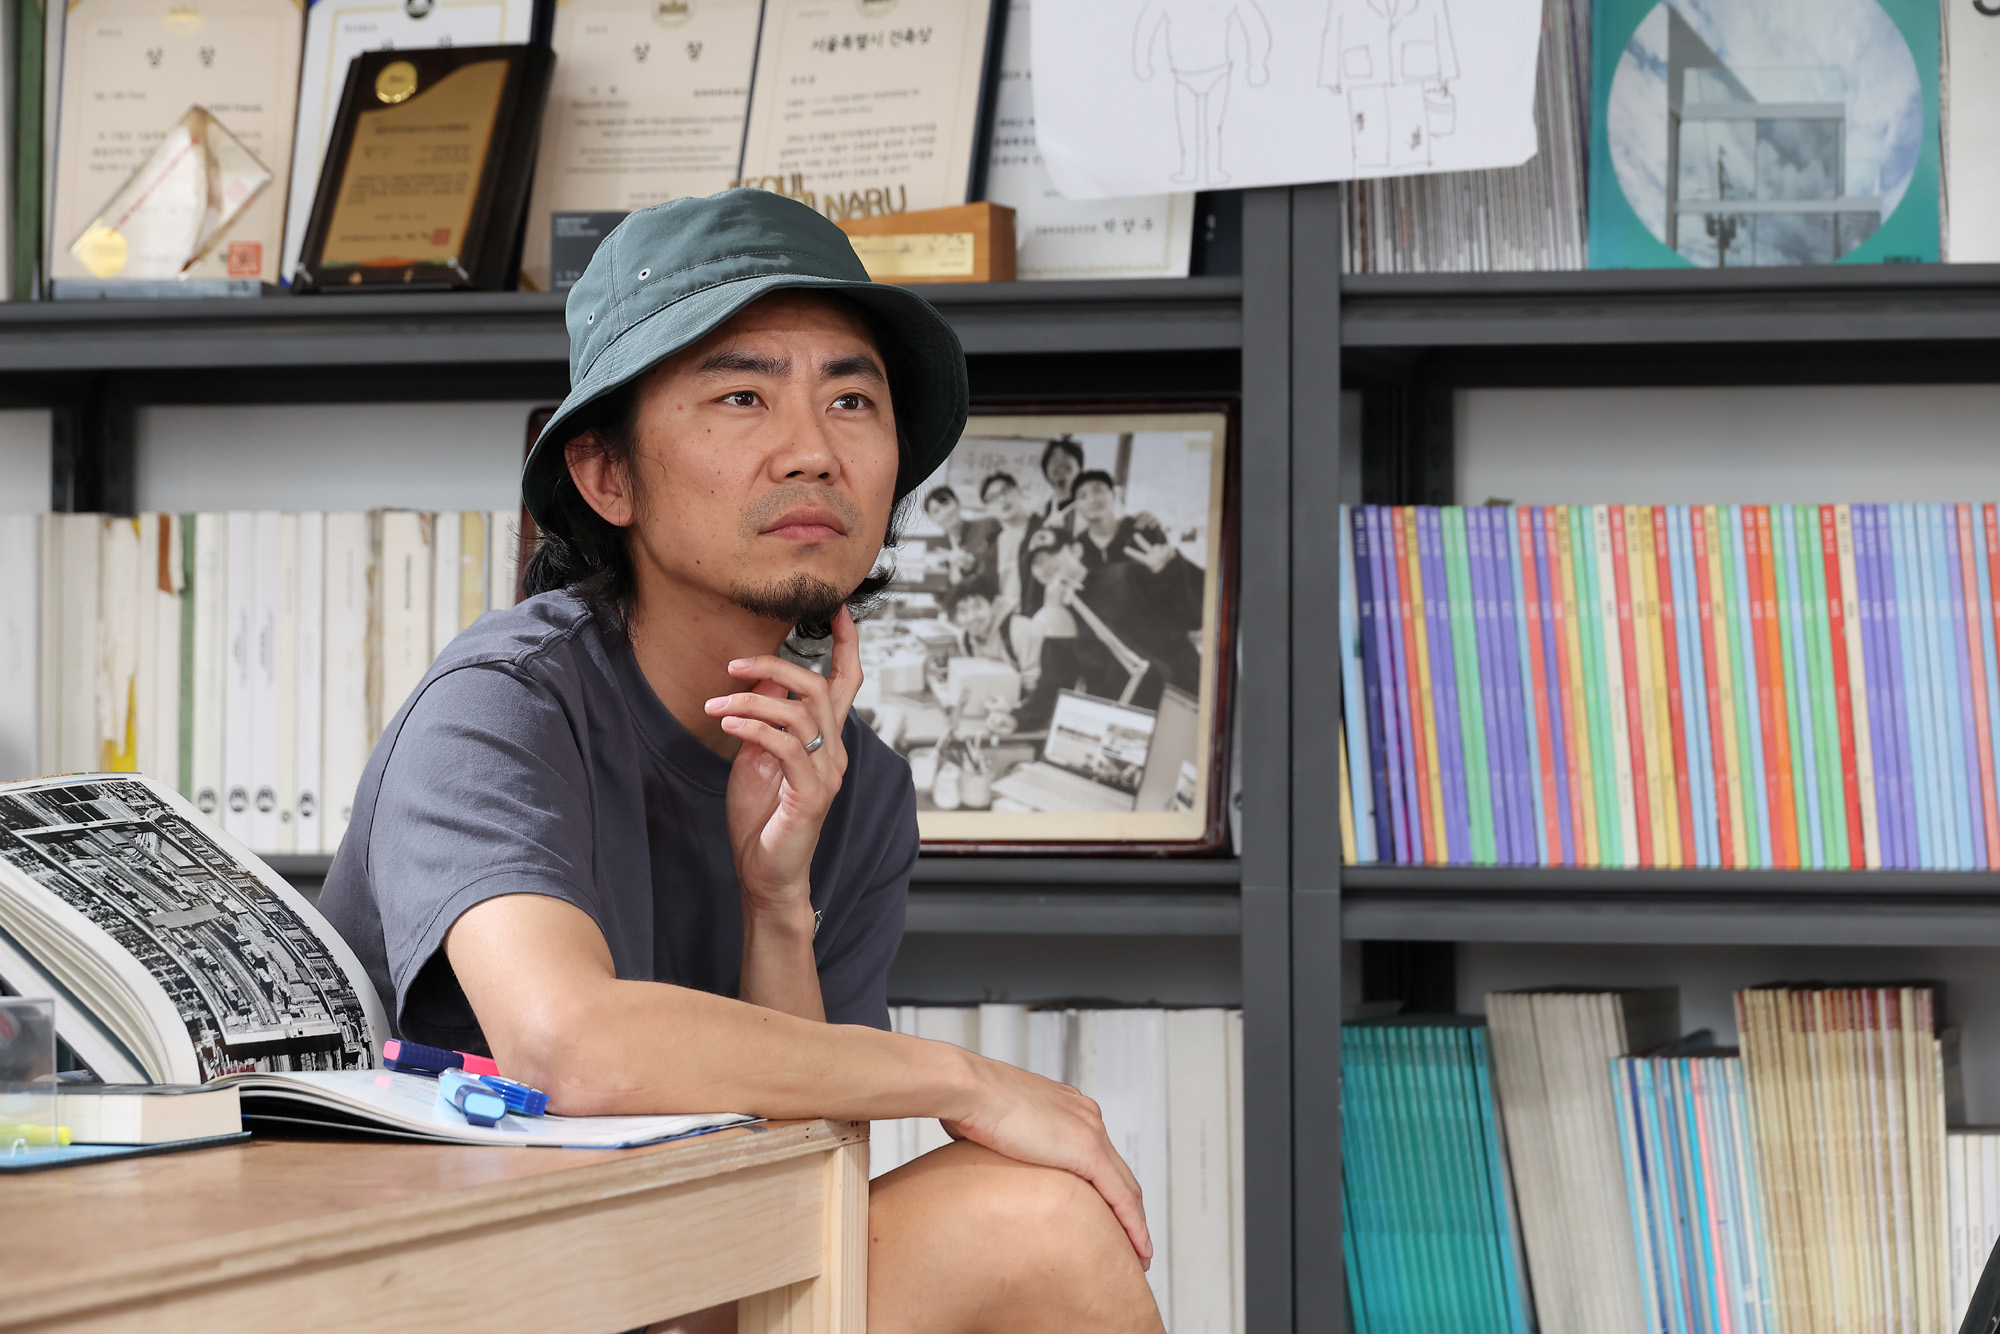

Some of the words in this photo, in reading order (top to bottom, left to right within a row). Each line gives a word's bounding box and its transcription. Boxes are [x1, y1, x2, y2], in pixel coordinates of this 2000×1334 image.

[810, 31, 884, 54] 서울특별시
[889, 26, 933, 48] 건축상
[825, 185, 907, 220] NARU
